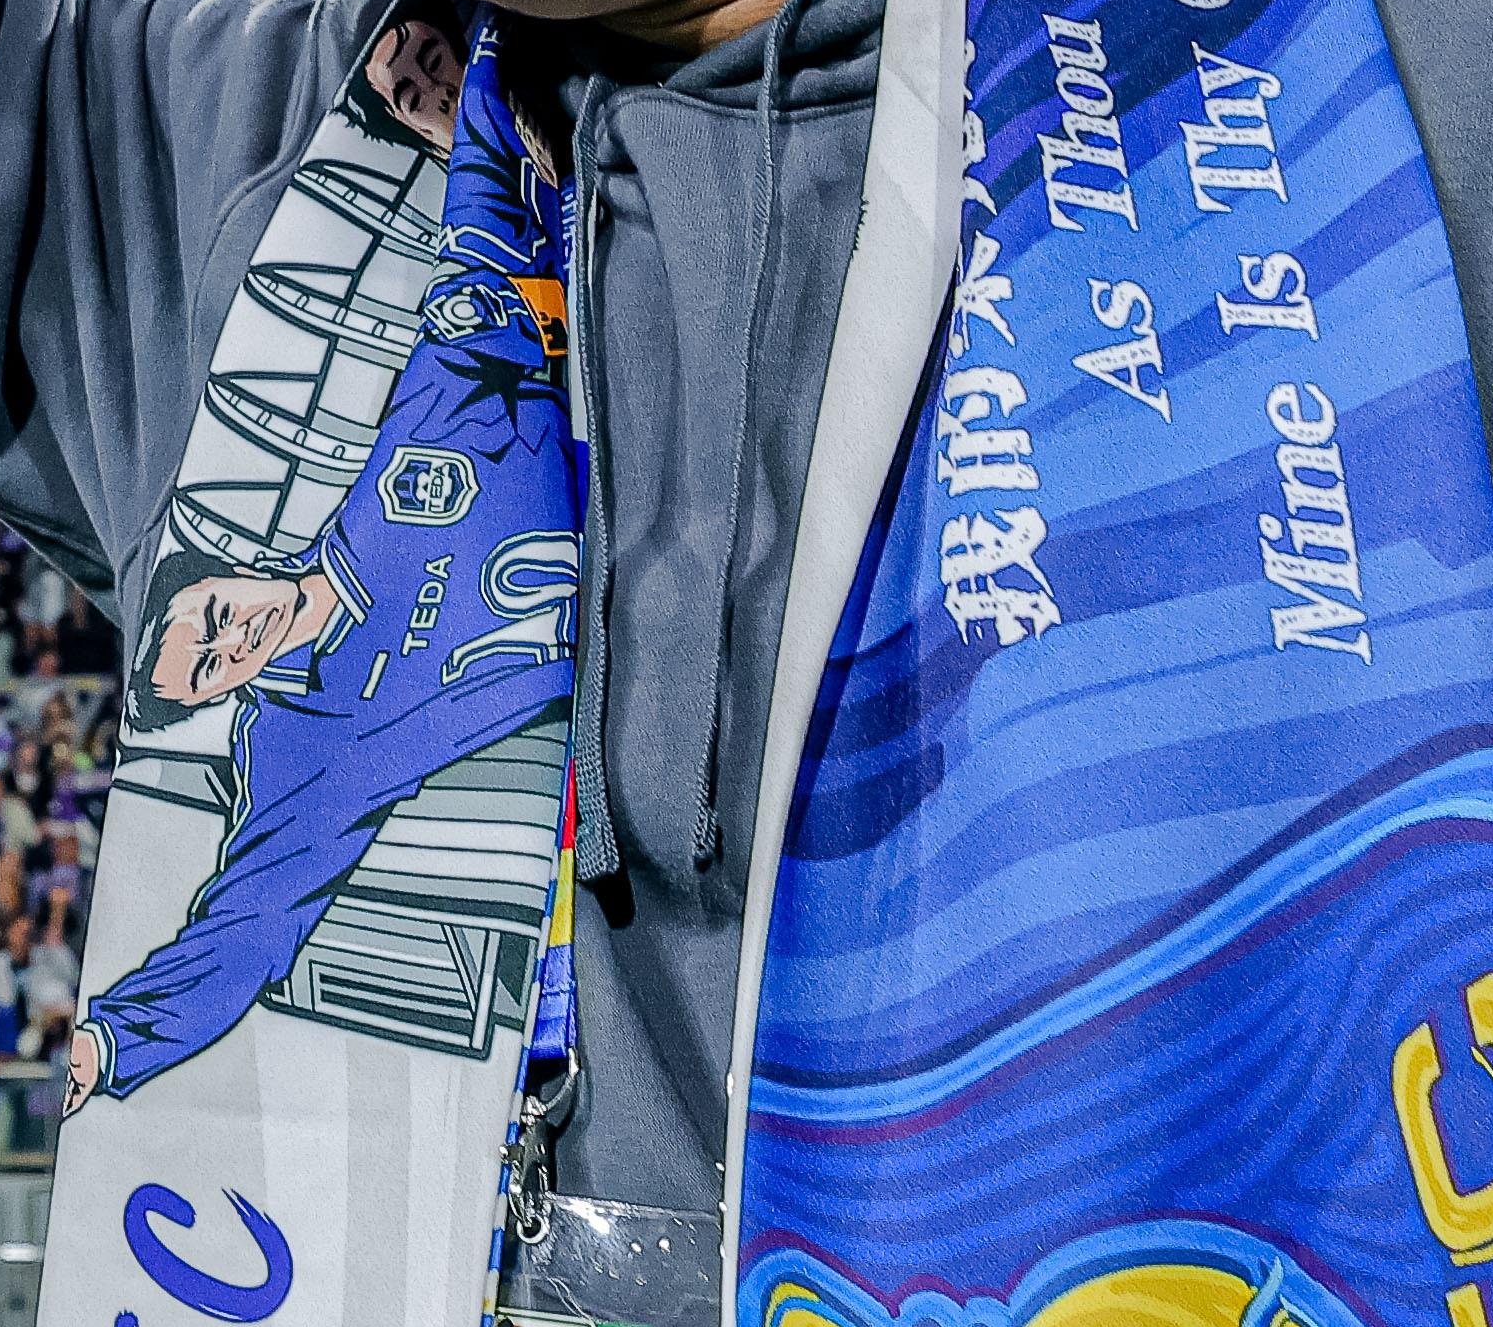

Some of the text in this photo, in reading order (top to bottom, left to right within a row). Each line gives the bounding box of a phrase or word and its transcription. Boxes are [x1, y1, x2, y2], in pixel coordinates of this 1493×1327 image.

[1041, 14, 1138, 232] Thou
[1188, 41, 1287, 215] Thy
[1072, 276, 1172, 422] As
[1218, 250, 1318, 340] Is
[1260, 381, 1372, 664] Mine
[401, 554, 455, 657] TEDA
